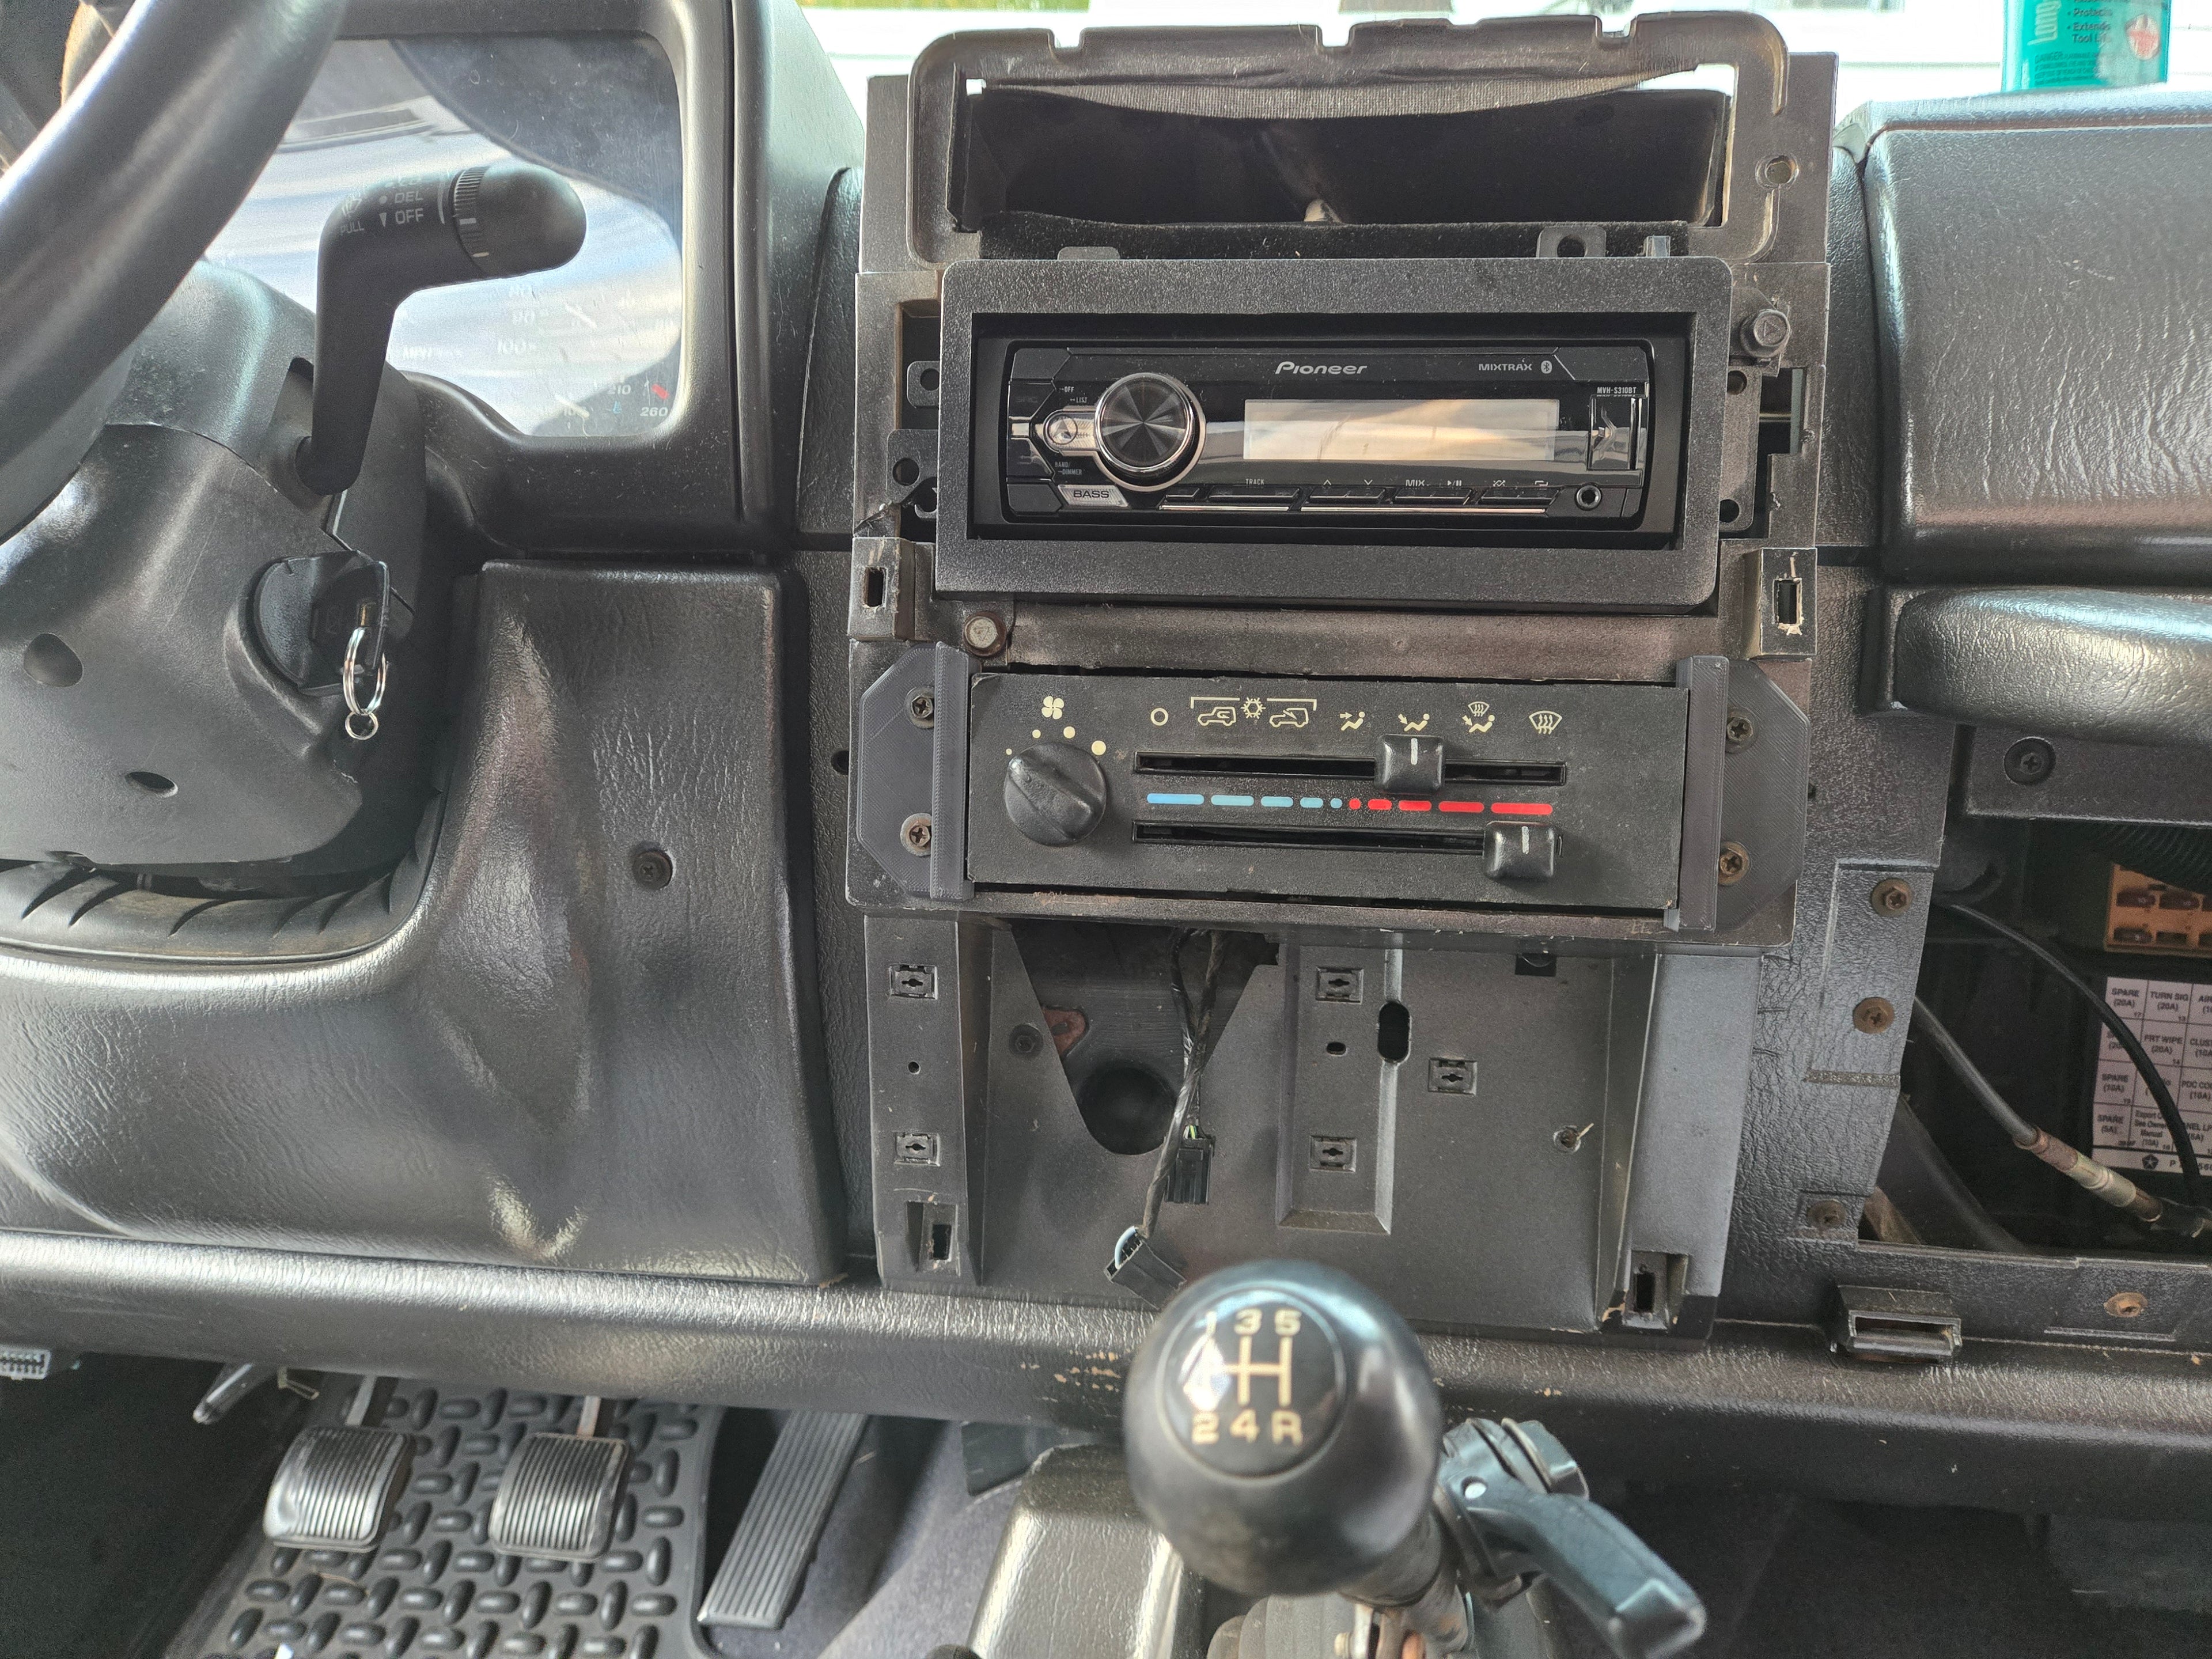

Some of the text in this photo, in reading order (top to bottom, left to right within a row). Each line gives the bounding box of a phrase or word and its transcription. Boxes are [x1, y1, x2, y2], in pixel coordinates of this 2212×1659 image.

[2072, 34, 2093, 43] Tool
[395, 191, 423, 204] DEL
[395, 207, 425, 225] OFF
[340, 221, 365, 235] PULL
[497, 338, 527, 355] 100
[1275, 361, 1368, 374] Pioneer
[607, 384, 632, 395] 210
[640, 407, 668, 417] 260
[1073, 490, 1109, 498] BASS
[2111, 988, 2139, 997] SPARE
[2150, 991, 2189, 1001] TURN SIG
[2157, 1002, 2179, 1011] (20A)
[2161, 1036, 2183, 1044] WIPE
[2102, 1074, 2128, 1082] SPARE
[2097, 1115, 2123, 1124] SPARE
[1233, 1308, 1263, 1335] 3
[1274, 1308, 1302, 1336] 5
[1191, 1409, 1303, 1445] 2 4 R
